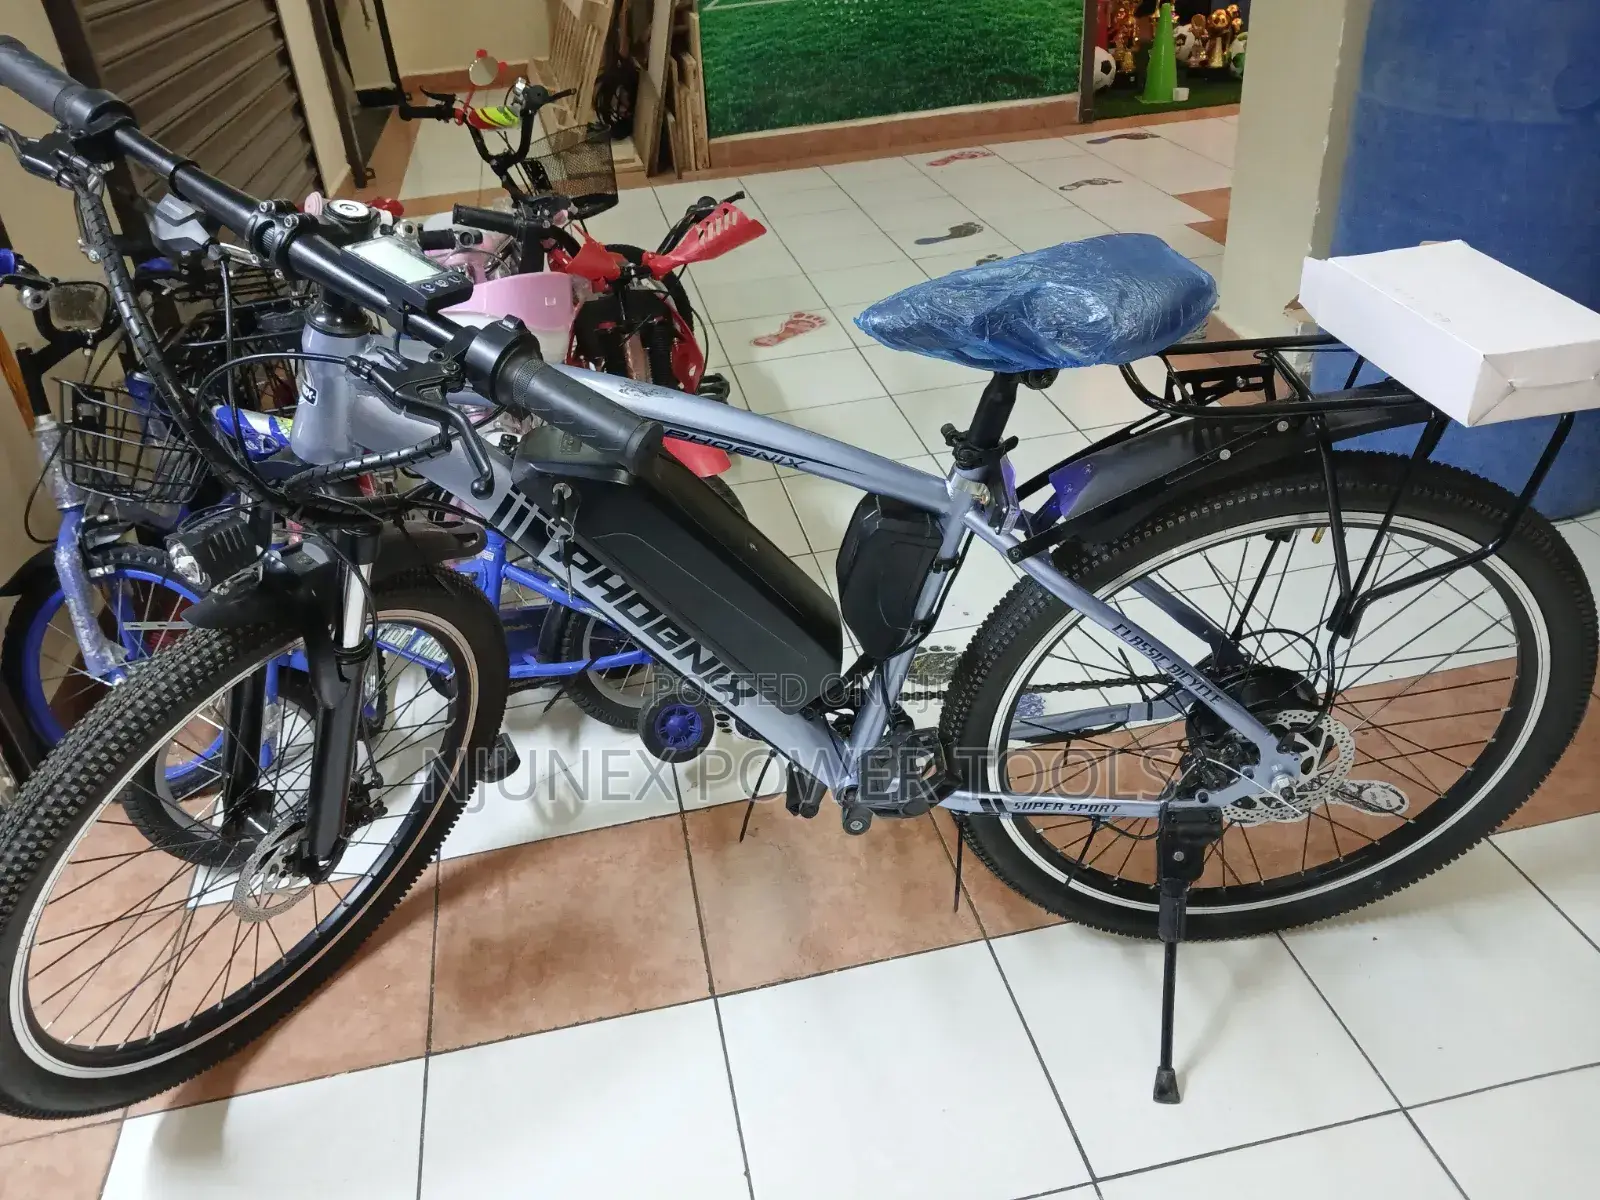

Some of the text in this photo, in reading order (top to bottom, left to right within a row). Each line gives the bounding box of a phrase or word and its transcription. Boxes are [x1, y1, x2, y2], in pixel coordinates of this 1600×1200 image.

[665, 429, 806, 468] PHOENIX
[549, 541, 758, 707] PHOENIX
[1111, 623, 1223, 705] CLASSIC BICYCLE
[1013, 802, 1121, 813] SUPER SPORT
